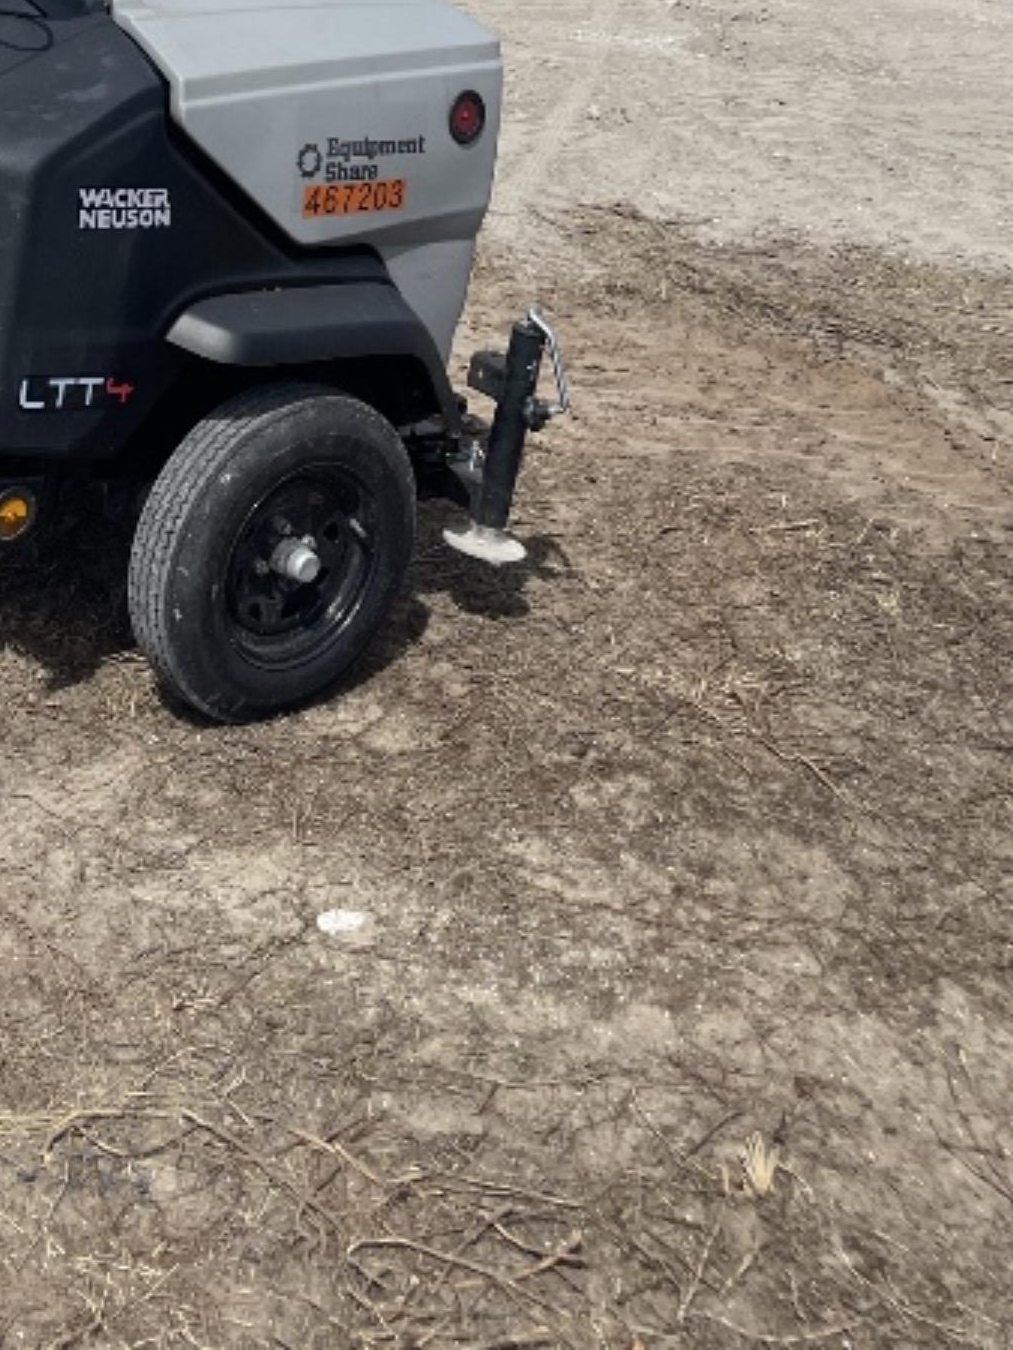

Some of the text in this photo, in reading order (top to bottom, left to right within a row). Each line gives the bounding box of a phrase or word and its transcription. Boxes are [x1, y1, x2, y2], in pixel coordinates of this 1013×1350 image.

[326, 135, 425, 161] Equipment
[326, 162, 378, 181] Share
[79, 188, 170, 207] WACKER
[304, 180, 402, 214] 467203
[79, 209, 171, 229] NEUSON
[19, 377, 134, 409] LTT4
